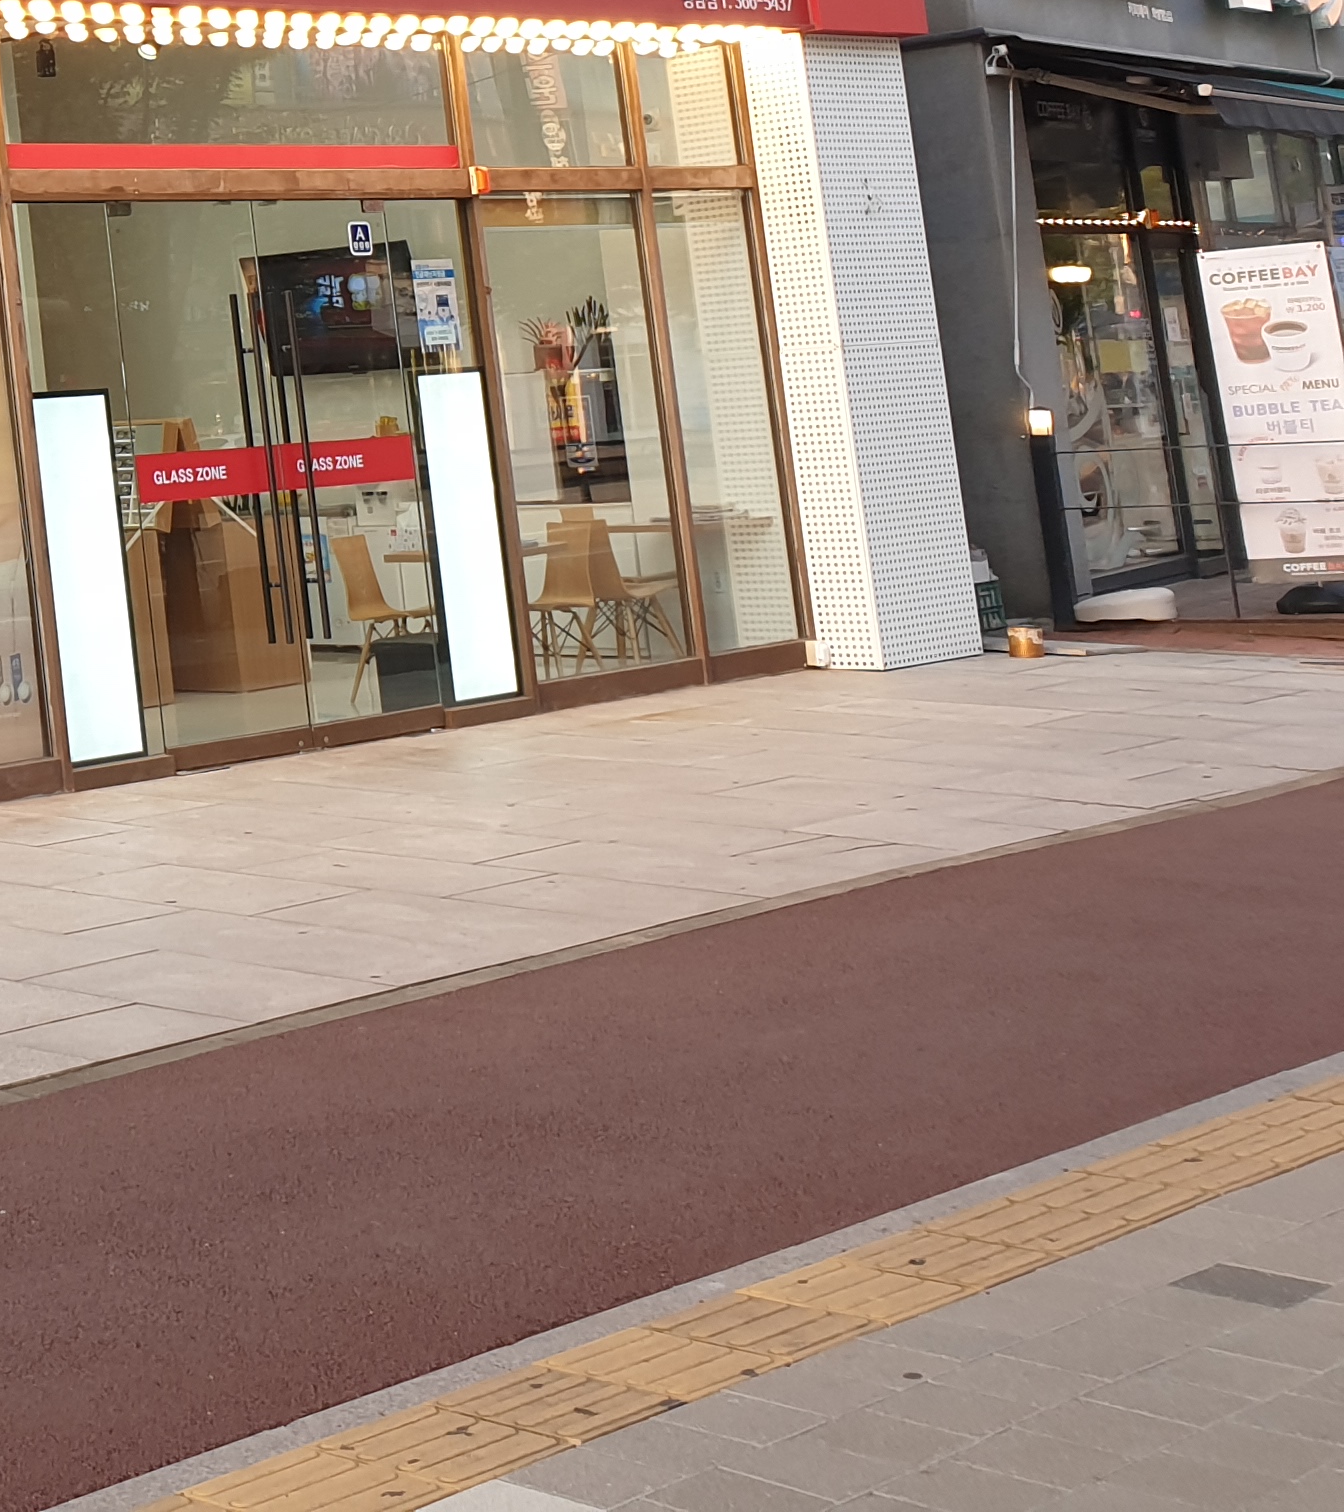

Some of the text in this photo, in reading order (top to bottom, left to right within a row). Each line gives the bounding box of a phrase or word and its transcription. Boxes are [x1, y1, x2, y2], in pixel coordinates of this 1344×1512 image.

[1209, 264, 1319, 287] COFFEEBAY
[1228, 383, 1278, 397] SPECIAL
[1302, 378, 1340, 391] MENU
[1232, 399, 1344, 418] BUBBLE TEA
[296, 454, 364, 473] GASS ZONE
[153, 465, 228, 486] GLASS ZONE
